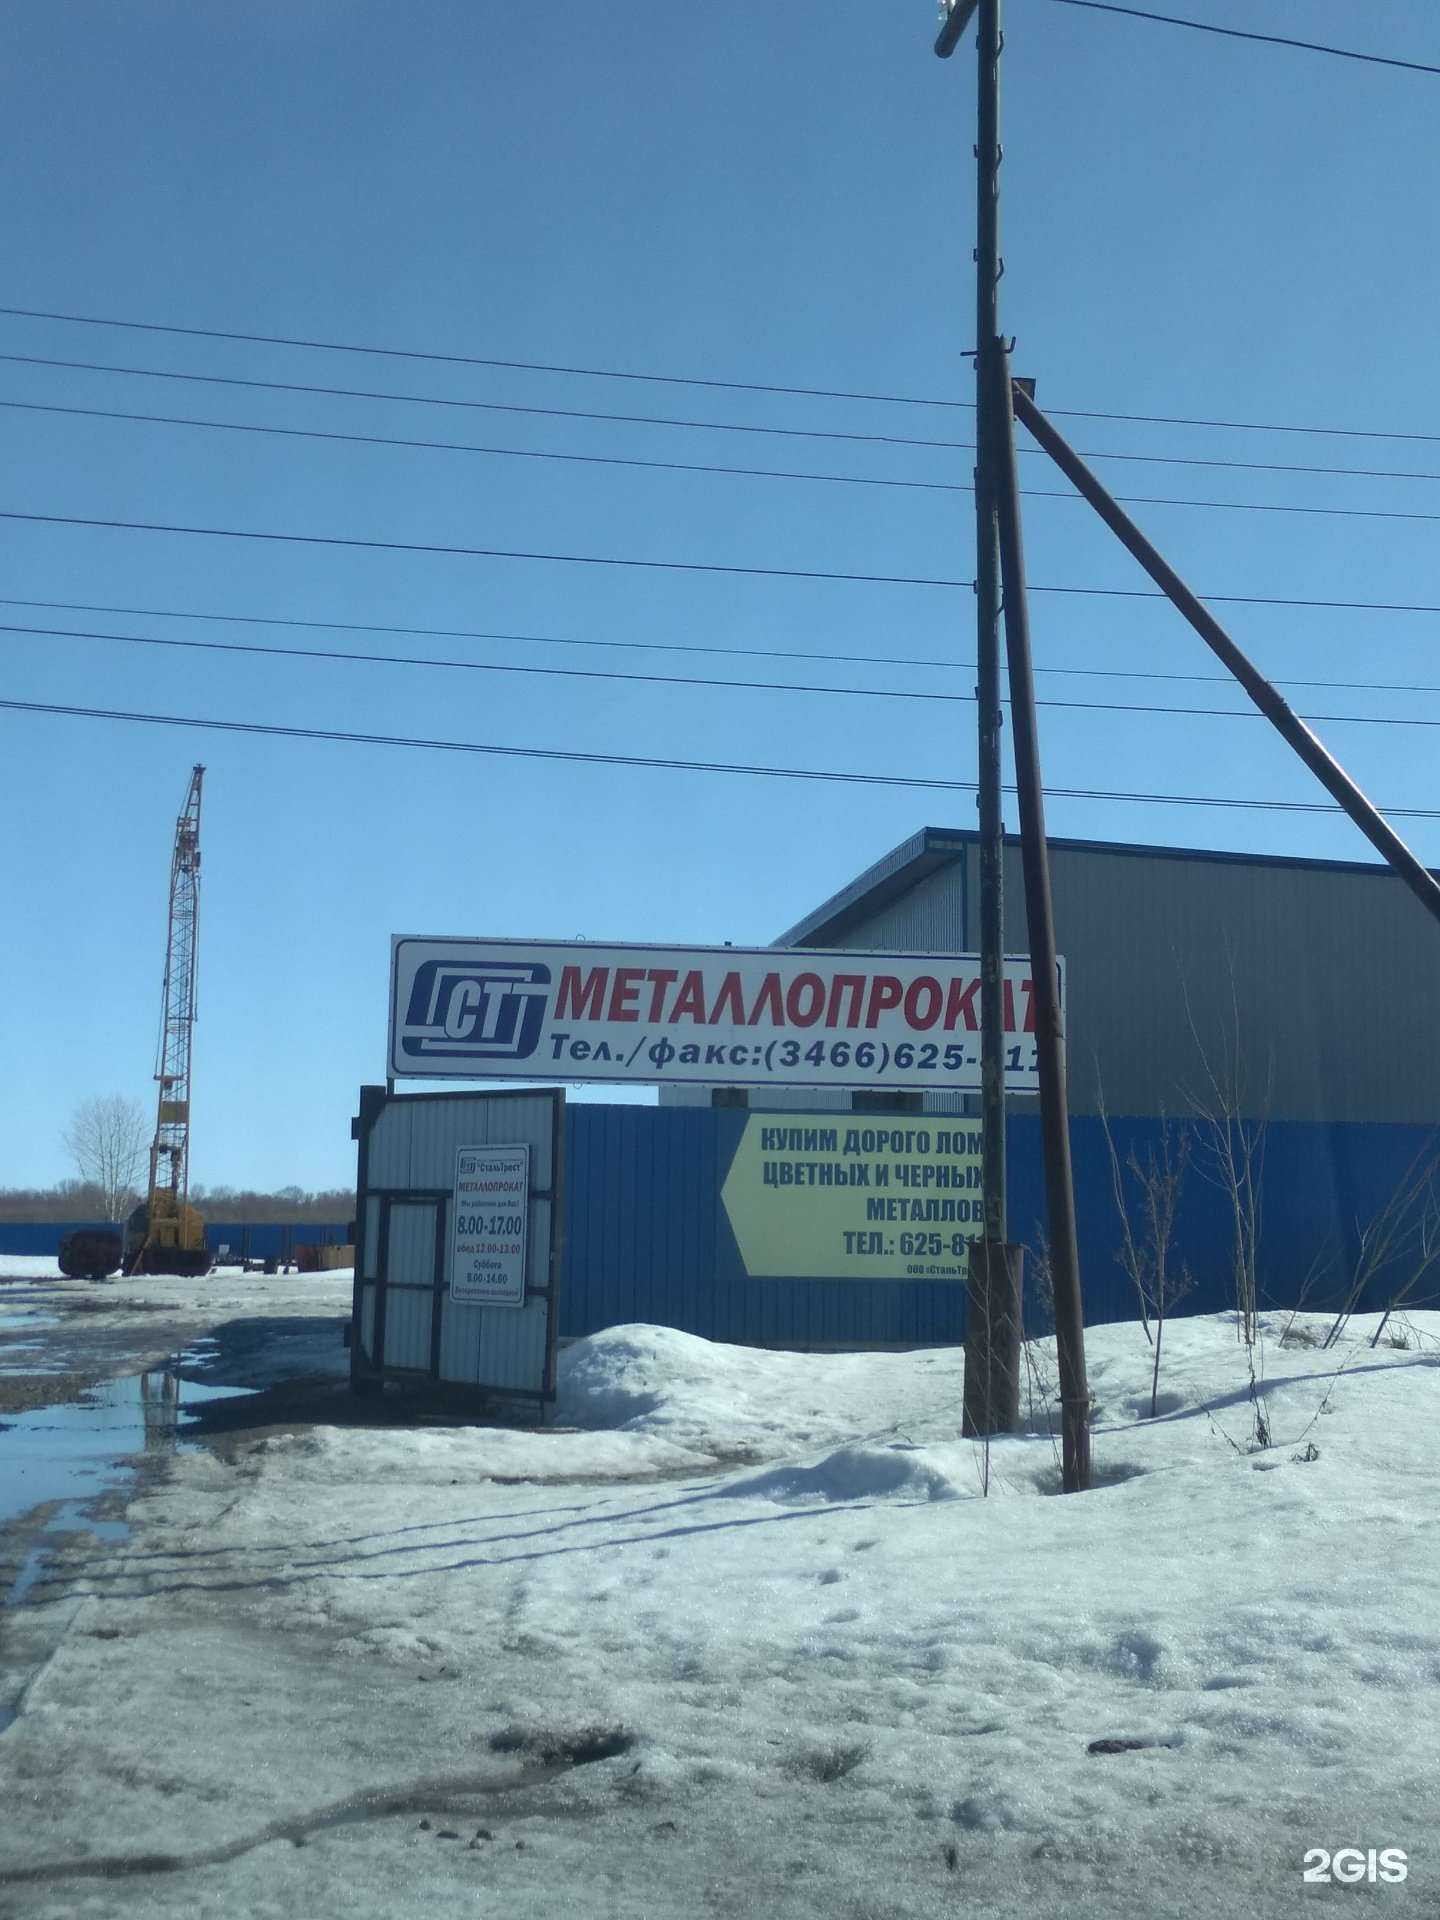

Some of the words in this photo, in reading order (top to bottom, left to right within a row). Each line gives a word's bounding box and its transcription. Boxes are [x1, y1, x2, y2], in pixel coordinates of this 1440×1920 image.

[761, 1127, 838, 1152] КУПИМ
[843, 1129, 930, 1156] ДОРОГО
[936, 1131, 983, 1155] ЛОМ
[763, 1162, 870, 1188] ЦВЕТНЫХ
[875, 1163, 889, 1187] И
[895, 1164, 983, 1189] ЧЕРНЫХ
[866, 1198, 984, 1223] МЕТАЛЛОВ
[457, 1215, 522, 1236] 8.00-17.00
[843, 1231, 894, 1256] ТЕЛ.:
[900, 1232, 976, 1257] 625-8
